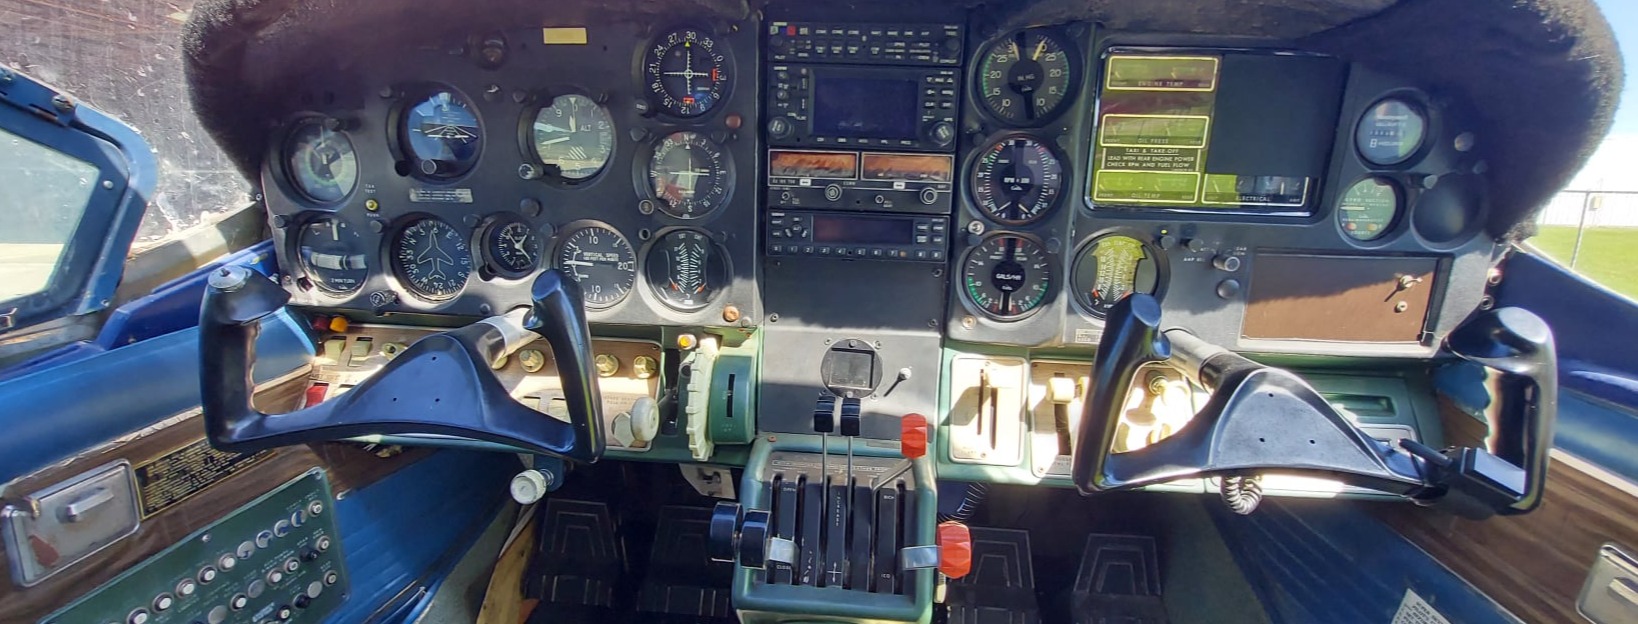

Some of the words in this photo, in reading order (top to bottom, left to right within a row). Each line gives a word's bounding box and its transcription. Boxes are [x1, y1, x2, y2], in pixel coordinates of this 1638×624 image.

[668, 33, 677, 43] 27
[686, 31, 696, 40] 30
[703, 38, 713, 48] 33
[654, 44, 663, 56] 24
[997, 54, 1008, 63] 25
[1045, 53, 1056, 61] 25
[649, 63, 657, 73] 21
[990, 70, 1002, 78] 20
[1049, 69, 1061, 77] 20
[651, 82, 660, 93] 18
[1048, 86, 1057, 94] 15
[663, 98, 672, 108] 15
[1002, 99, 1011, 107] 10
[1036, 98, 1045, 106] 10
[556, 109, 562, 118] 9
[680, 106, 690, 114] 12
[580, 124, 592, 132] ALT
[598, 121, 605, 130] 2
[683, 133, 689, 141] N
[687, 205, 693, 213] S
[409, 237, 417, 245] N
[589, 236, 599, 245] 10
[406, 249, 414, 260] 33
[409, 263, 420, 274] 30
[617, 262, 628, 270] 20
[591, 285, 601, 294] 10
